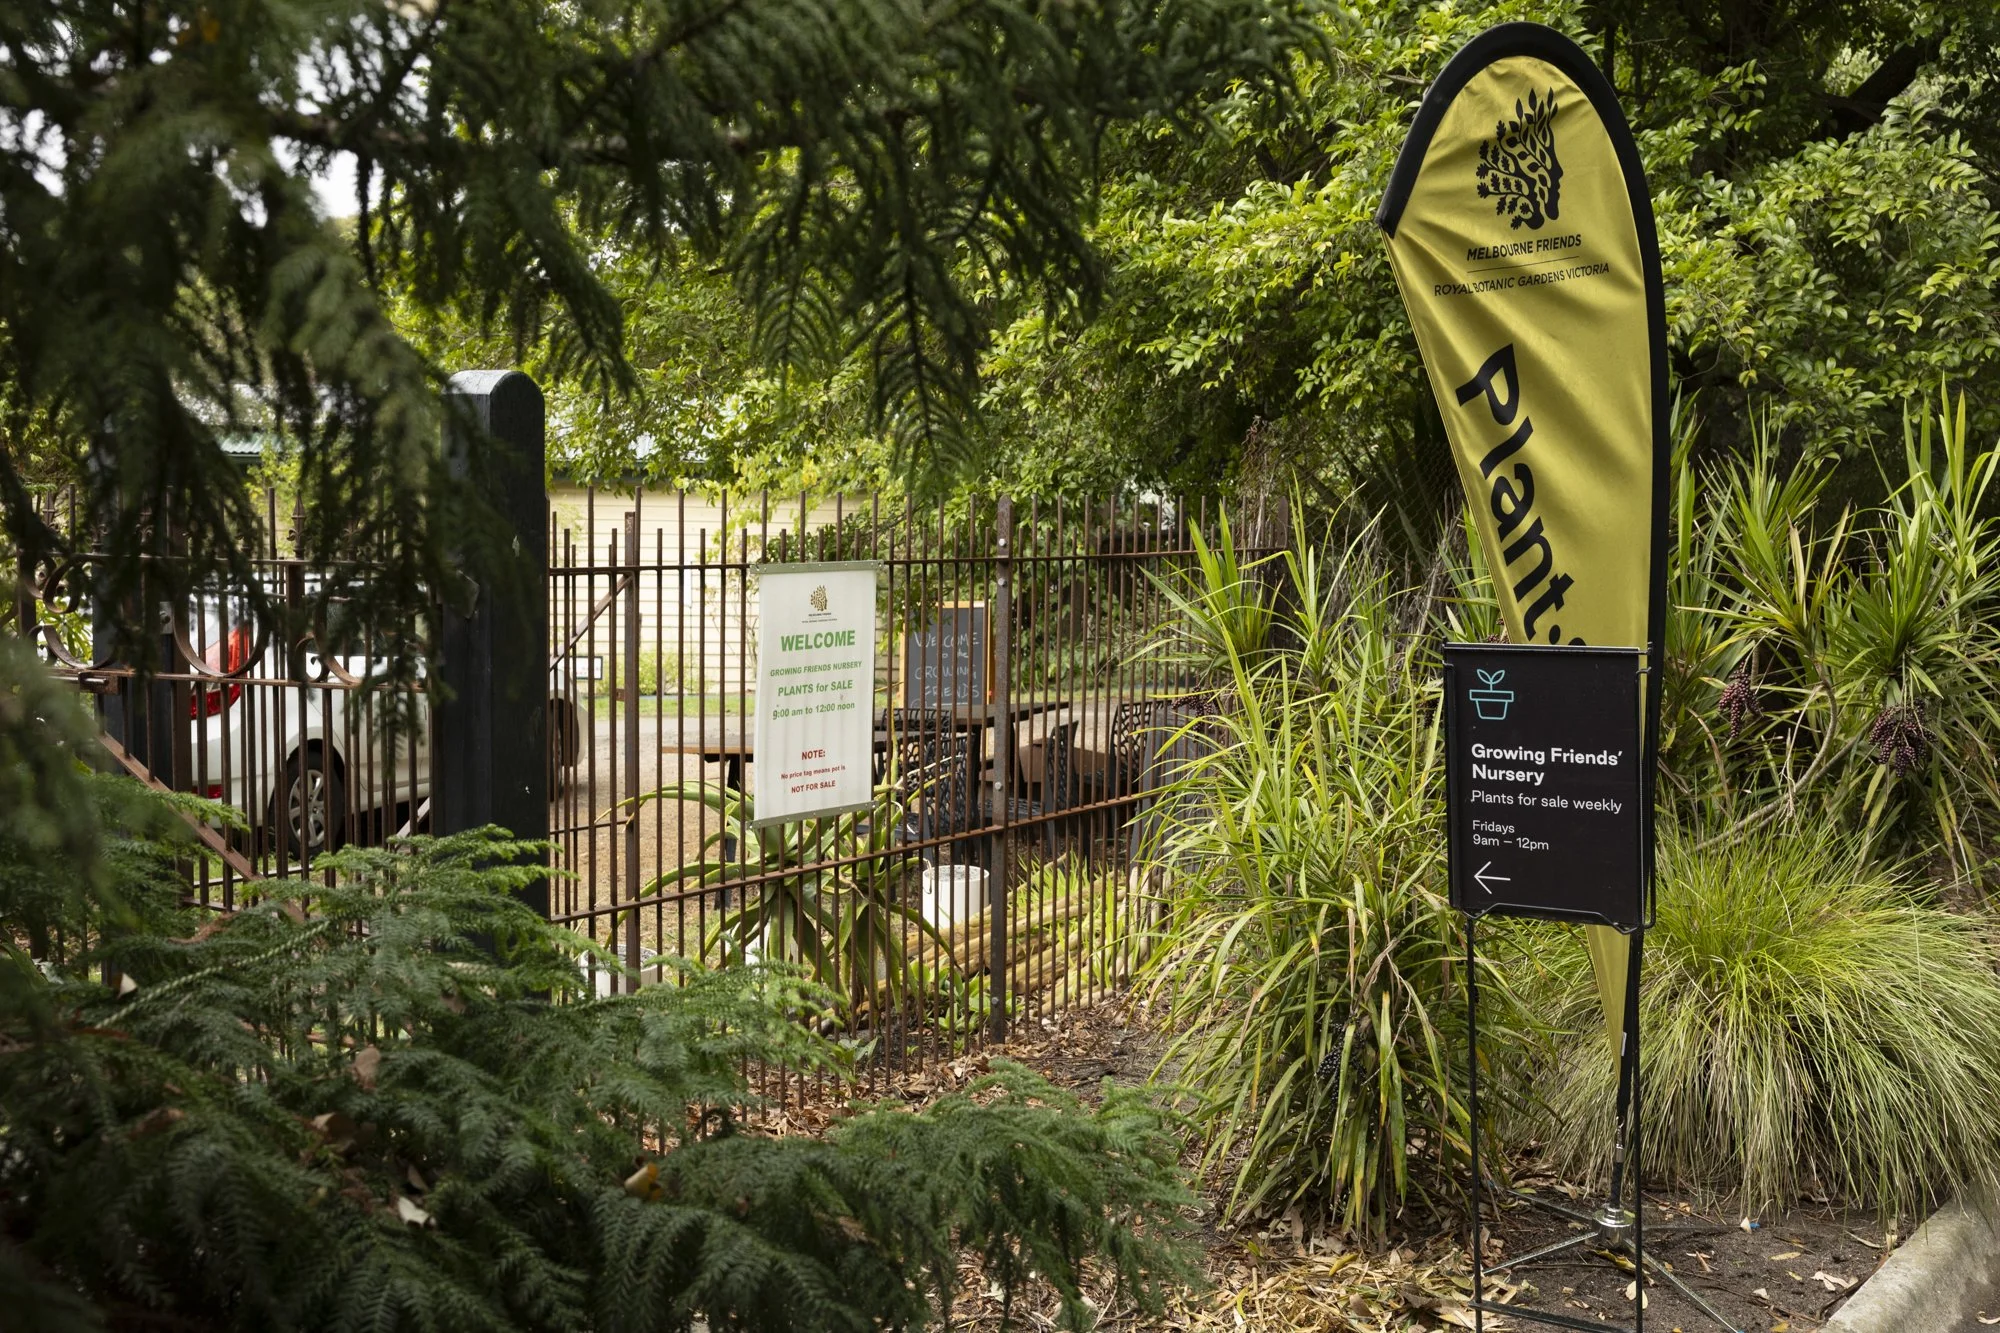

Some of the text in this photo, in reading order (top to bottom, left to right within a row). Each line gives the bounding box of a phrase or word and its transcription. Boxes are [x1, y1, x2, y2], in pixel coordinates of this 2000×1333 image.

[1466, 234, 1582, 261] MELBOURNE FRIENDS
[1434, 263, 1610, 296] ROYAL BOTANIC GARDENS VICTORIA
[1455, 343, 1587, 646] Plant
[781, 630, 855, 652] WELCOME
[913, 631, 979, 648] WECOME
[770, 661, 862, 677] GROWING FRIENDS NURSERY
[778, 680, 853, 697] PLANTS for SALE
[772, 708, 790, 720] 9:00
[805, 706, 813, 714] to
[815, 704, 835, 713] 12:00
[837, 702, 855, 710] noon
[801, 749, 826, 760] NOTE:
[1471, 743, 1545, 765] Growing
[1472, 764, 1545, 786] Nursery
[791, 780, 836, 793] NOT FOR SALE
[1471, 790, 1623, 815] Plants for sale weekly
[1472, 819, 1515, 835] Fridays
[1472, 833, 1500, 847] 9am
[1516, 837, 1549, 852] 12pm
